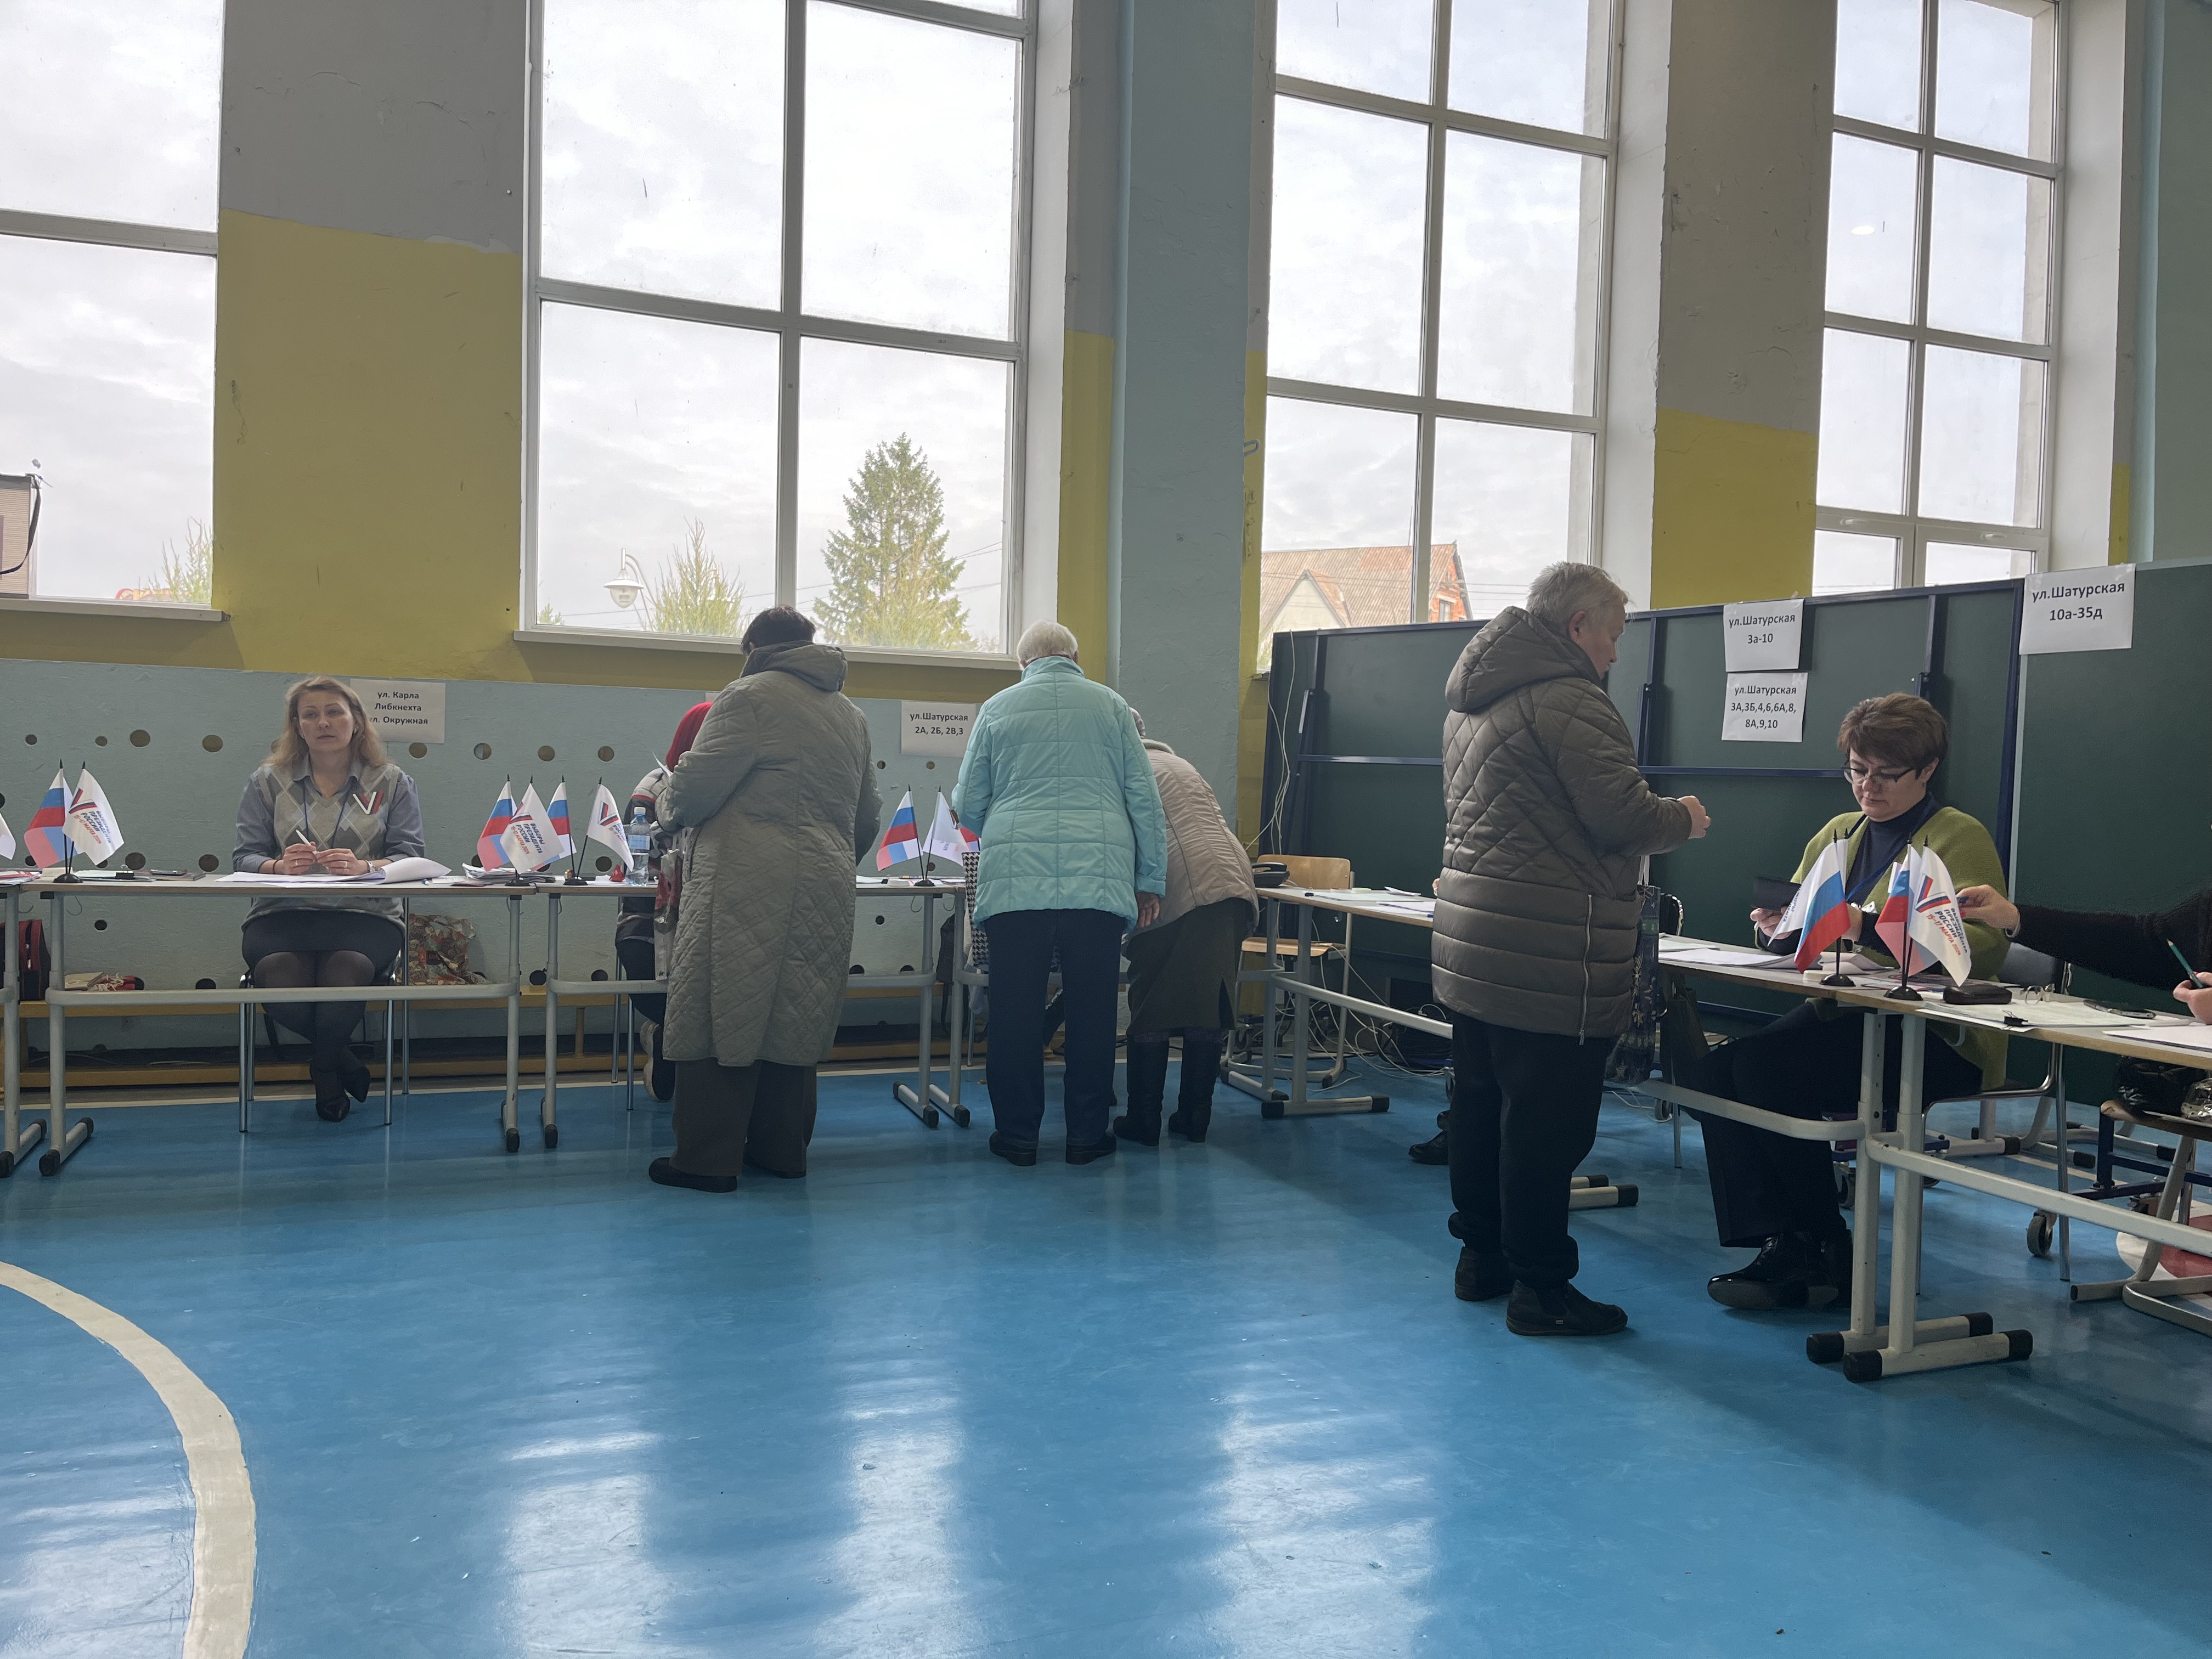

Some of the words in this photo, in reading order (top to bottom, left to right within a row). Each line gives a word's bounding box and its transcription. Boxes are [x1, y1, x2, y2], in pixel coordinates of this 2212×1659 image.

[2032, 583, 2125, 602] ул.Шатурская
[2050, 606, 2103, 620] 10а-35д
[1729, 614, 1795, 629] ул.Шатурская
[1747, 633, 1773, 644] 3а-10
[393, 691, 419, 700] Карла
[1735, 685, 1797, 696] ул.Шатурская
[374, 703, 422, 712] Либкнехта
[1731, 702, 1796, 714] 3А,3Б,4,6,6А,8,
[383, 716, 428, 725] Окружная
[910, 712, 968, 723] ул.Шатурская
[915, 726, 928, 735] 2А,
[930, 726, 944, 736] 2Б,
[945, 727, 963, 736] 2В,3
[1745, 719, 1778, 730] 8А,9,10
[81, 812, 100, 832] РОССИИ
[516, 825, 531, 842] РОССИИ
[523, 823, 543, 854] ПРЕЗИДЕНТА
[530, 823, 545, 844] ВЫБОРЫ
[1934, 911, 1957, 938] РОССИИ
[1939, 926, 1954, 943] МАРТА
